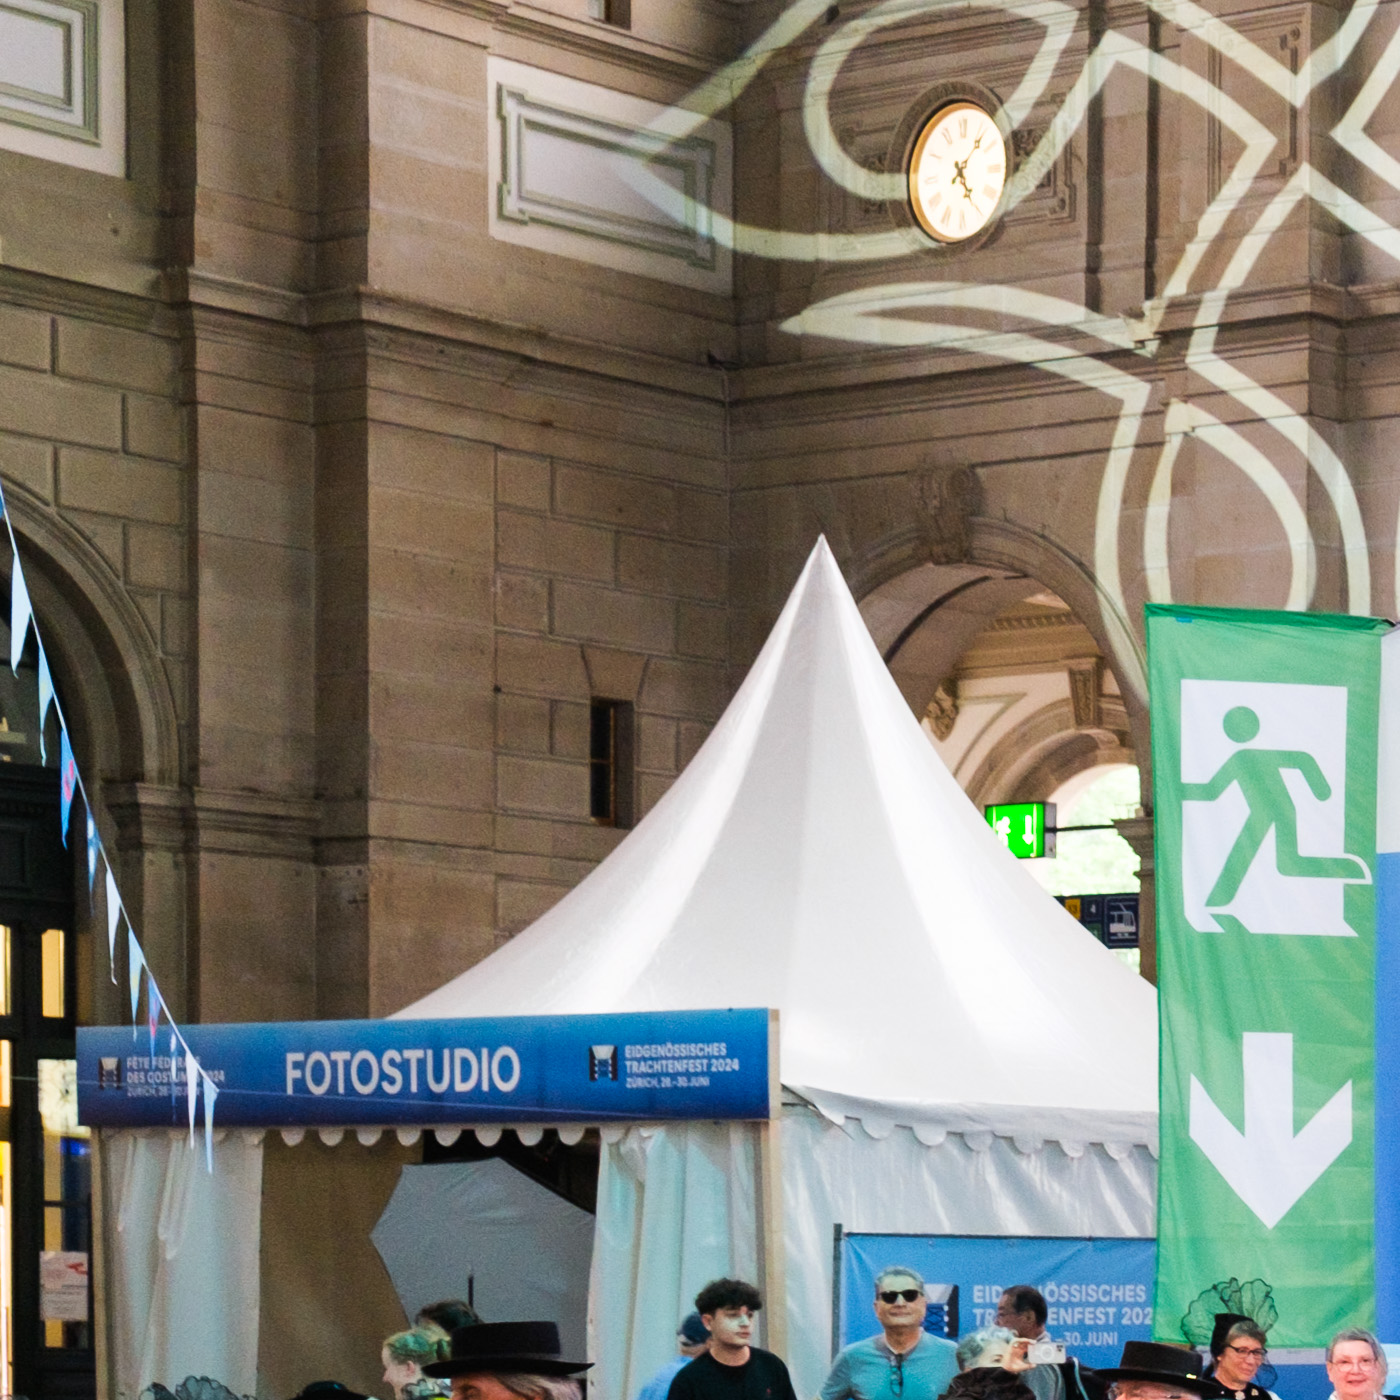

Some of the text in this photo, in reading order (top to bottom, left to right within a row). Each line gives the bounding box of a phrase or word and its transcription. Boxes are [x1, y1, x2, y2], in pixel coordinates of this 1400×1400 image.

[624, 1042, 727, 1058] EIDGENÖSSISCHES
[286, 1046, 521, 1096] FOTOSTUDIO
[624, 1058, 740, 1074] TRACHTENFEST 2024
[127, 1071, 145, 1083] DES
[973, 1282, 1146, 1304] EIDÖSSISCHES
[972, 1307, 1153, 1327] TRENFEST 202
